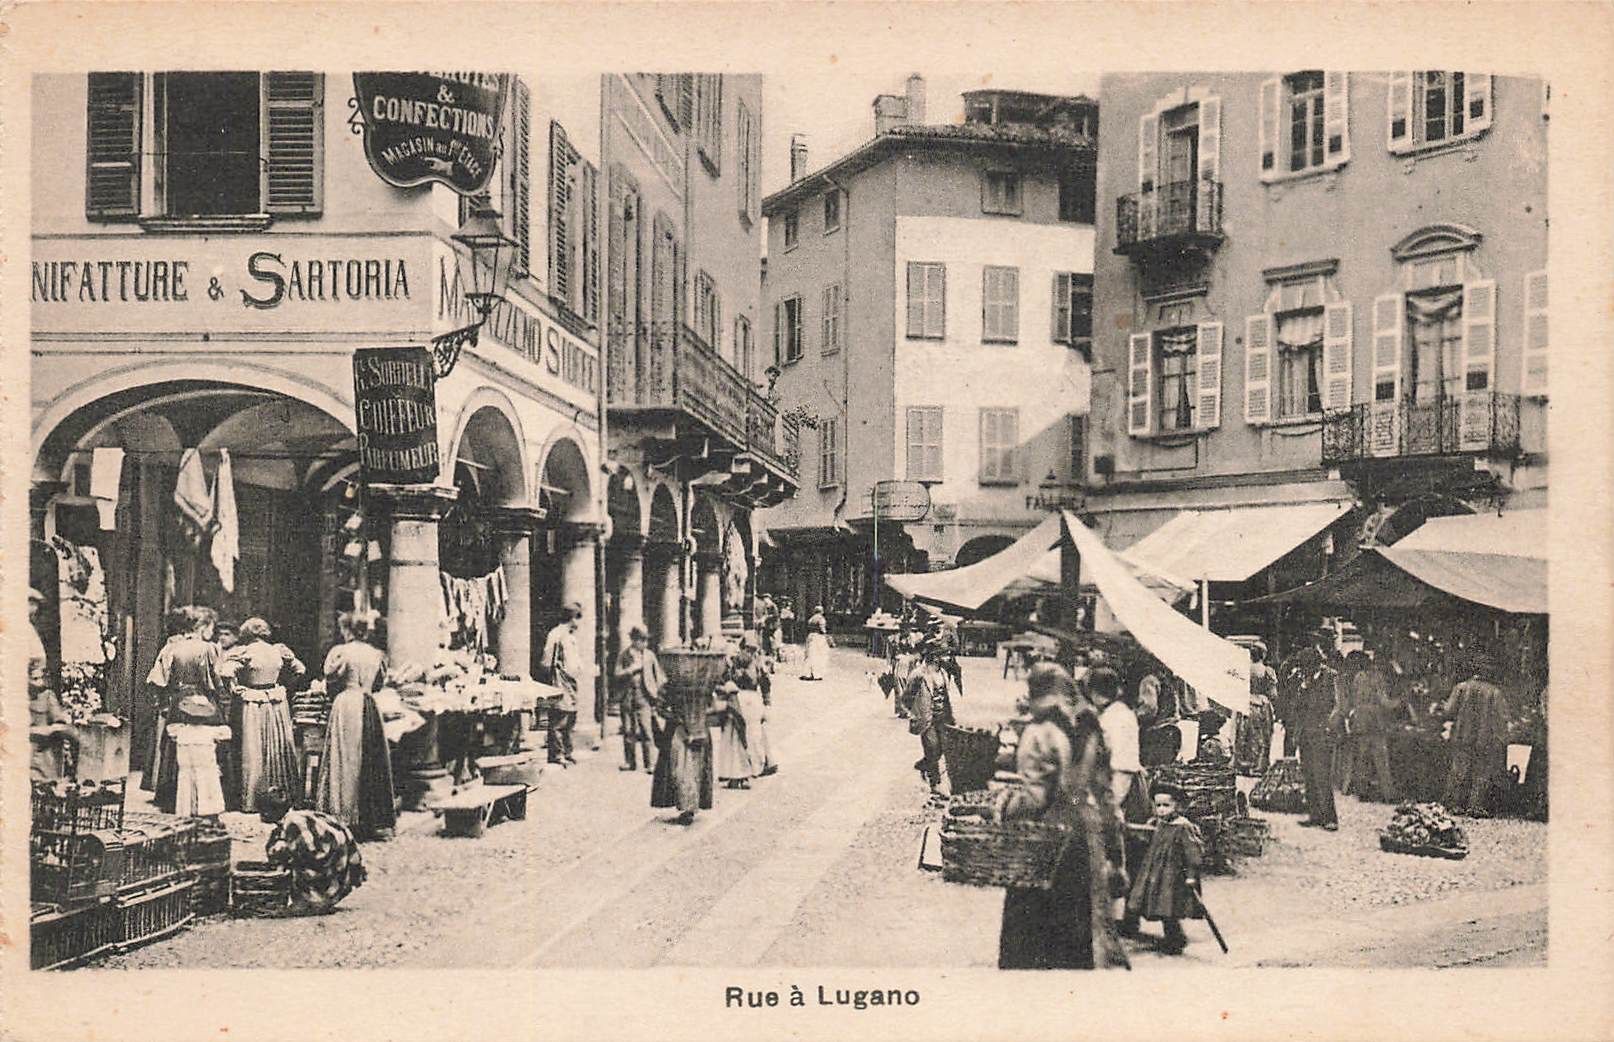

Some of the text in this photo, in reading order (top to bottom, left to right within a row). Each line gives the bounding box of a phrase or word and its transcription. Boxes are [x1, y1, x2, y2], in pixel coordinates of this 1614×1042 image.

[436, 84, 456, 104] &
[373, 95, 495, 140] CONFECTIONS
[381, 136, 434, 166] MAGASIN
[31, 251, 412, 309] NIFATTURE & SARTORIA
[360, 398, 436, 435] COIFFEUR
[359, 432, 439, 471] PARFUMEUR
